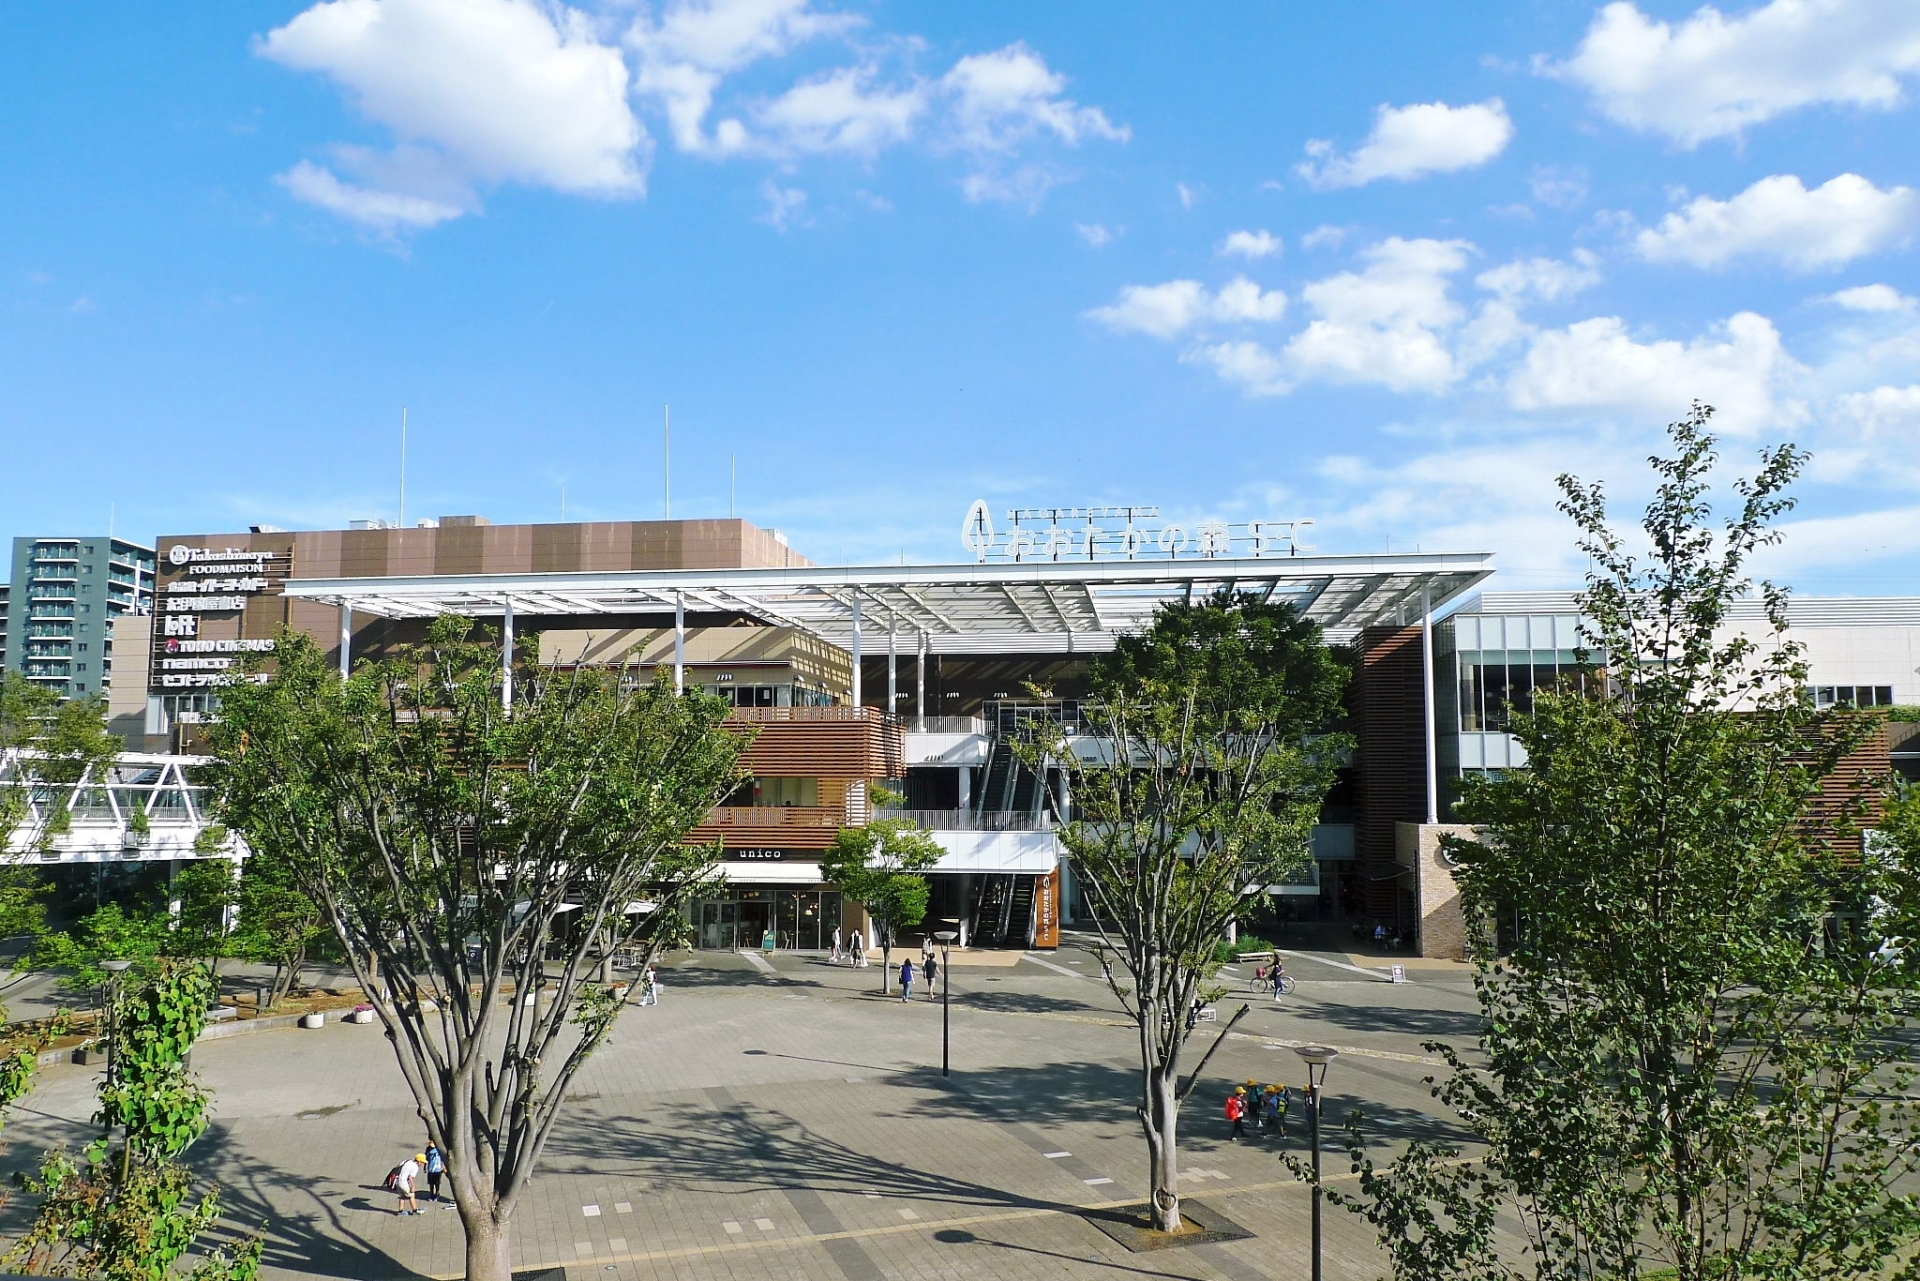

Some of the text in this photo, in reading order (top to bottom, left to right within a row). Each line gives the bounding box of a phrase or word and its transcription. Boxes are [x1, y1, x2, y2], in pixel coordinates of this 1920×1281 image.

[188, 548, 273, 563] Takashimaya
[189, 564, 263, 575] FOODMAISON
[179, 639, 275, 653] TOHO CINEMAS
[162, 658, 229, 669] namco
[740, 848, 781, 858] unico
